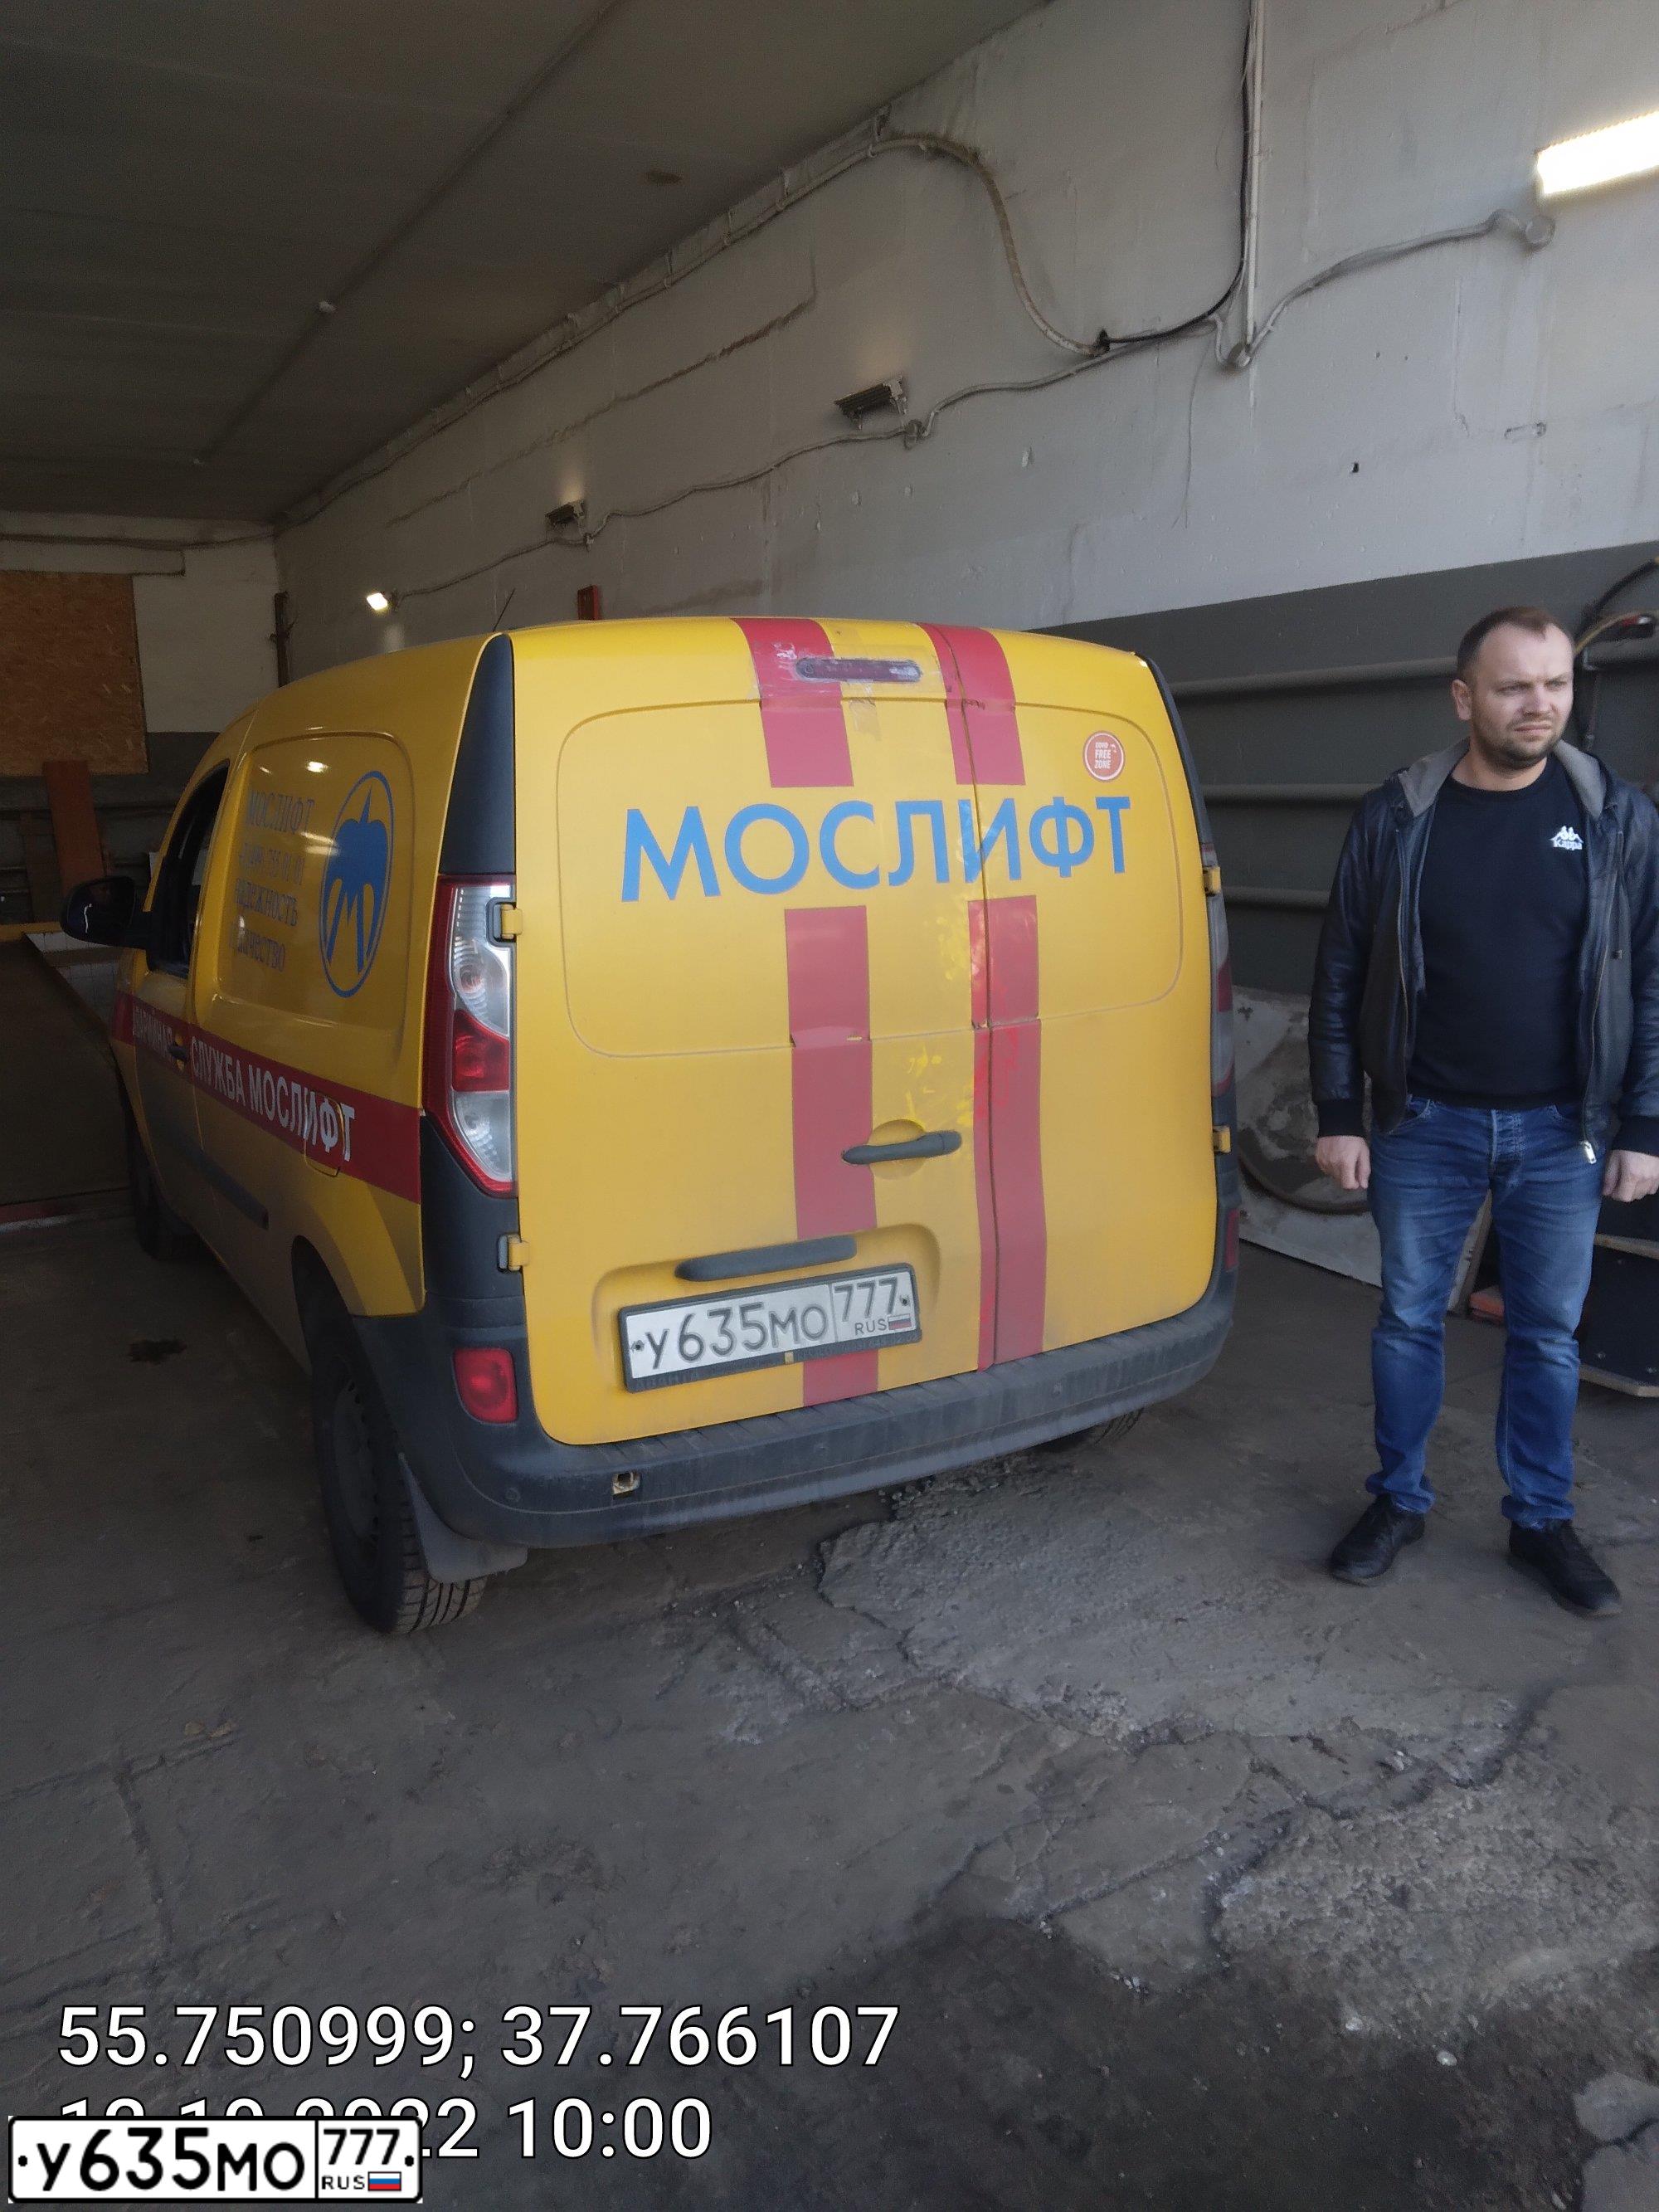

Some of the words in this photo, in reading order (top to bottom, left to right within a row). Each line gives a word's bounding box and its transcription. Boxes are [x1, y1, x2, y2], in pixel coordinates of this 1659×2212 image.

[1094, 759, 1112, 769] ZONE
[1095, 749, 1112, 759] FREE
[247, 789, 315, 835] МОСЛИФТ
[621, 796, 1131, 902] МОСЛИФТ
[1554, 840, 1583, 851] Kappa
[191, 1035, 246, 1107] СЛУЖБА
[248, 1064, 356, 1162] МОСЛИФТ
[645, 1301, 828, 1370] У635МО
[833, 1278, 899, 1323] 777
[854, 1318, 888, 1337] RUS
